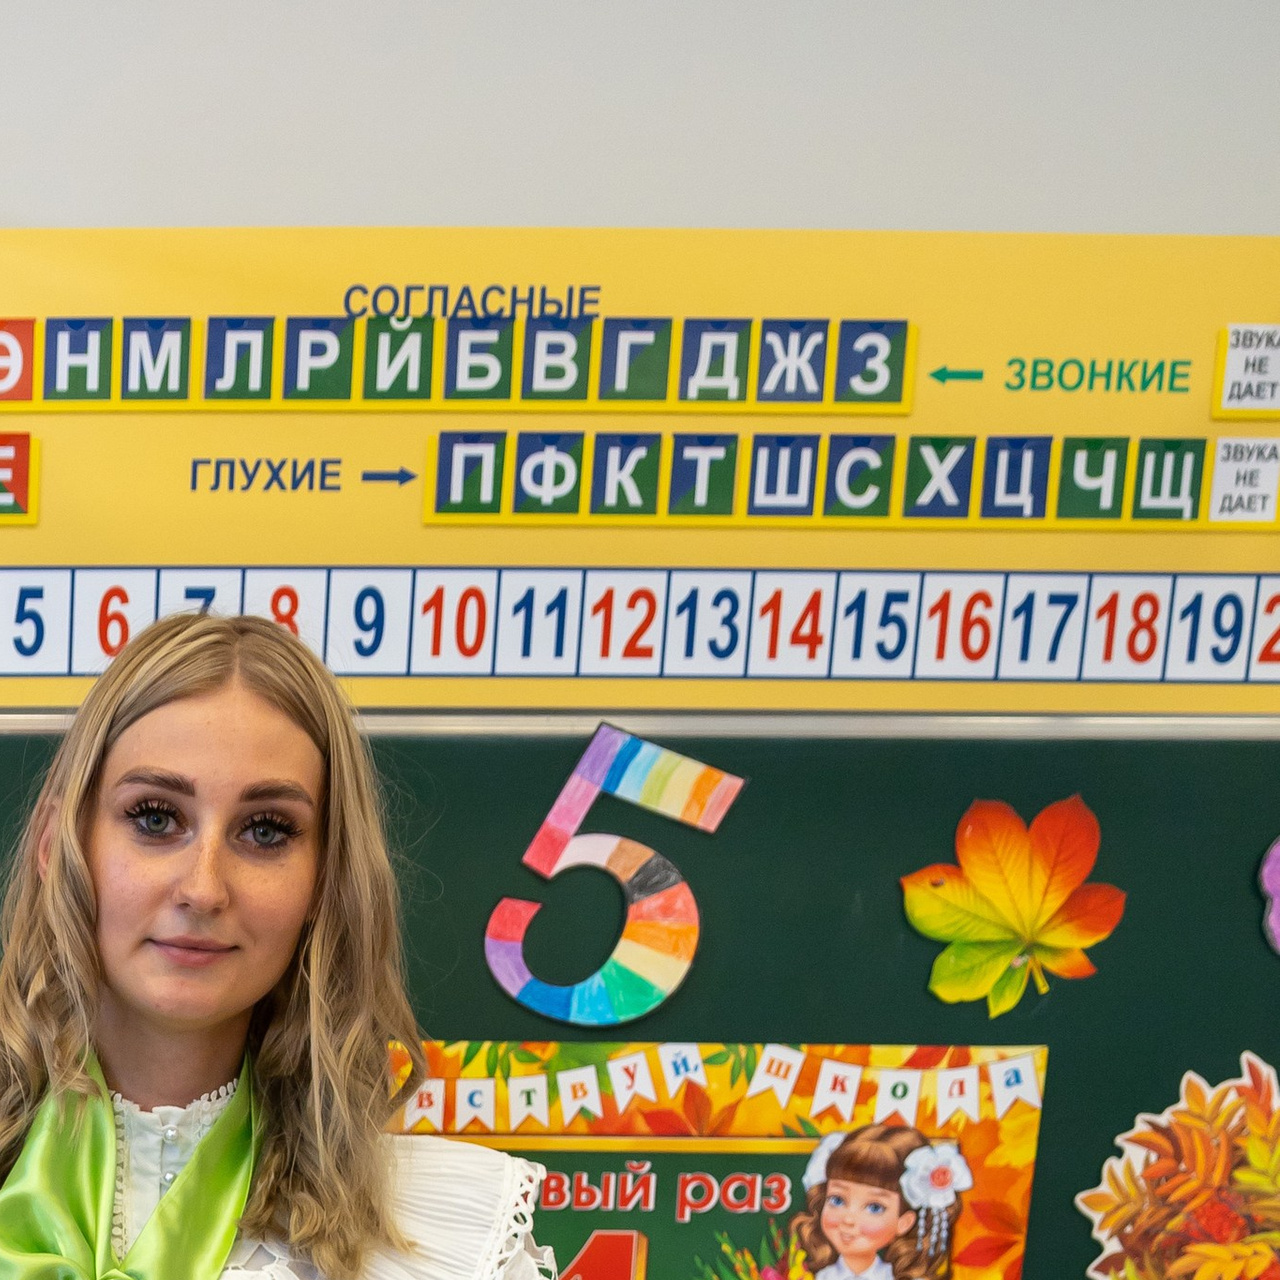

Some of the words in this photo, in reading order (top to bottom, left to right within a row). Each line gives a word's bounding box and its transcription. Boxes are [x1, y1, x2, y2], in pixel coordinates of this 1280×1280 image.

[343, 284, 601, 319] СОГЛАСНЫЕ
[1004, 358, 1192, 393] ЗВОНКИЕ
[1221, 443, 1279, 463] ЗВУКА
[191, 458, 342, 492] ГЛУХИЕ
[12, 586, 45, 657] 5
[98, 586, 130, 657] 6
[353, 586, 385, 657] 9
[421, 586, 487, 657] 10
[512, 586, 567, 658] 11
[591, 587, 657, 658] 12
[675, 588, 740, 659] 13
[758, 588, 823, 660] 14
[844, 589, 910, 661] 15
[927, 590, 994, 662] 16
[1012, 592, 1079, 663] 17
[1095, 592, 1160, 664] 18
[1177, 593, 1245, 664] 19
[676, 1172, 793, 1224] раз
